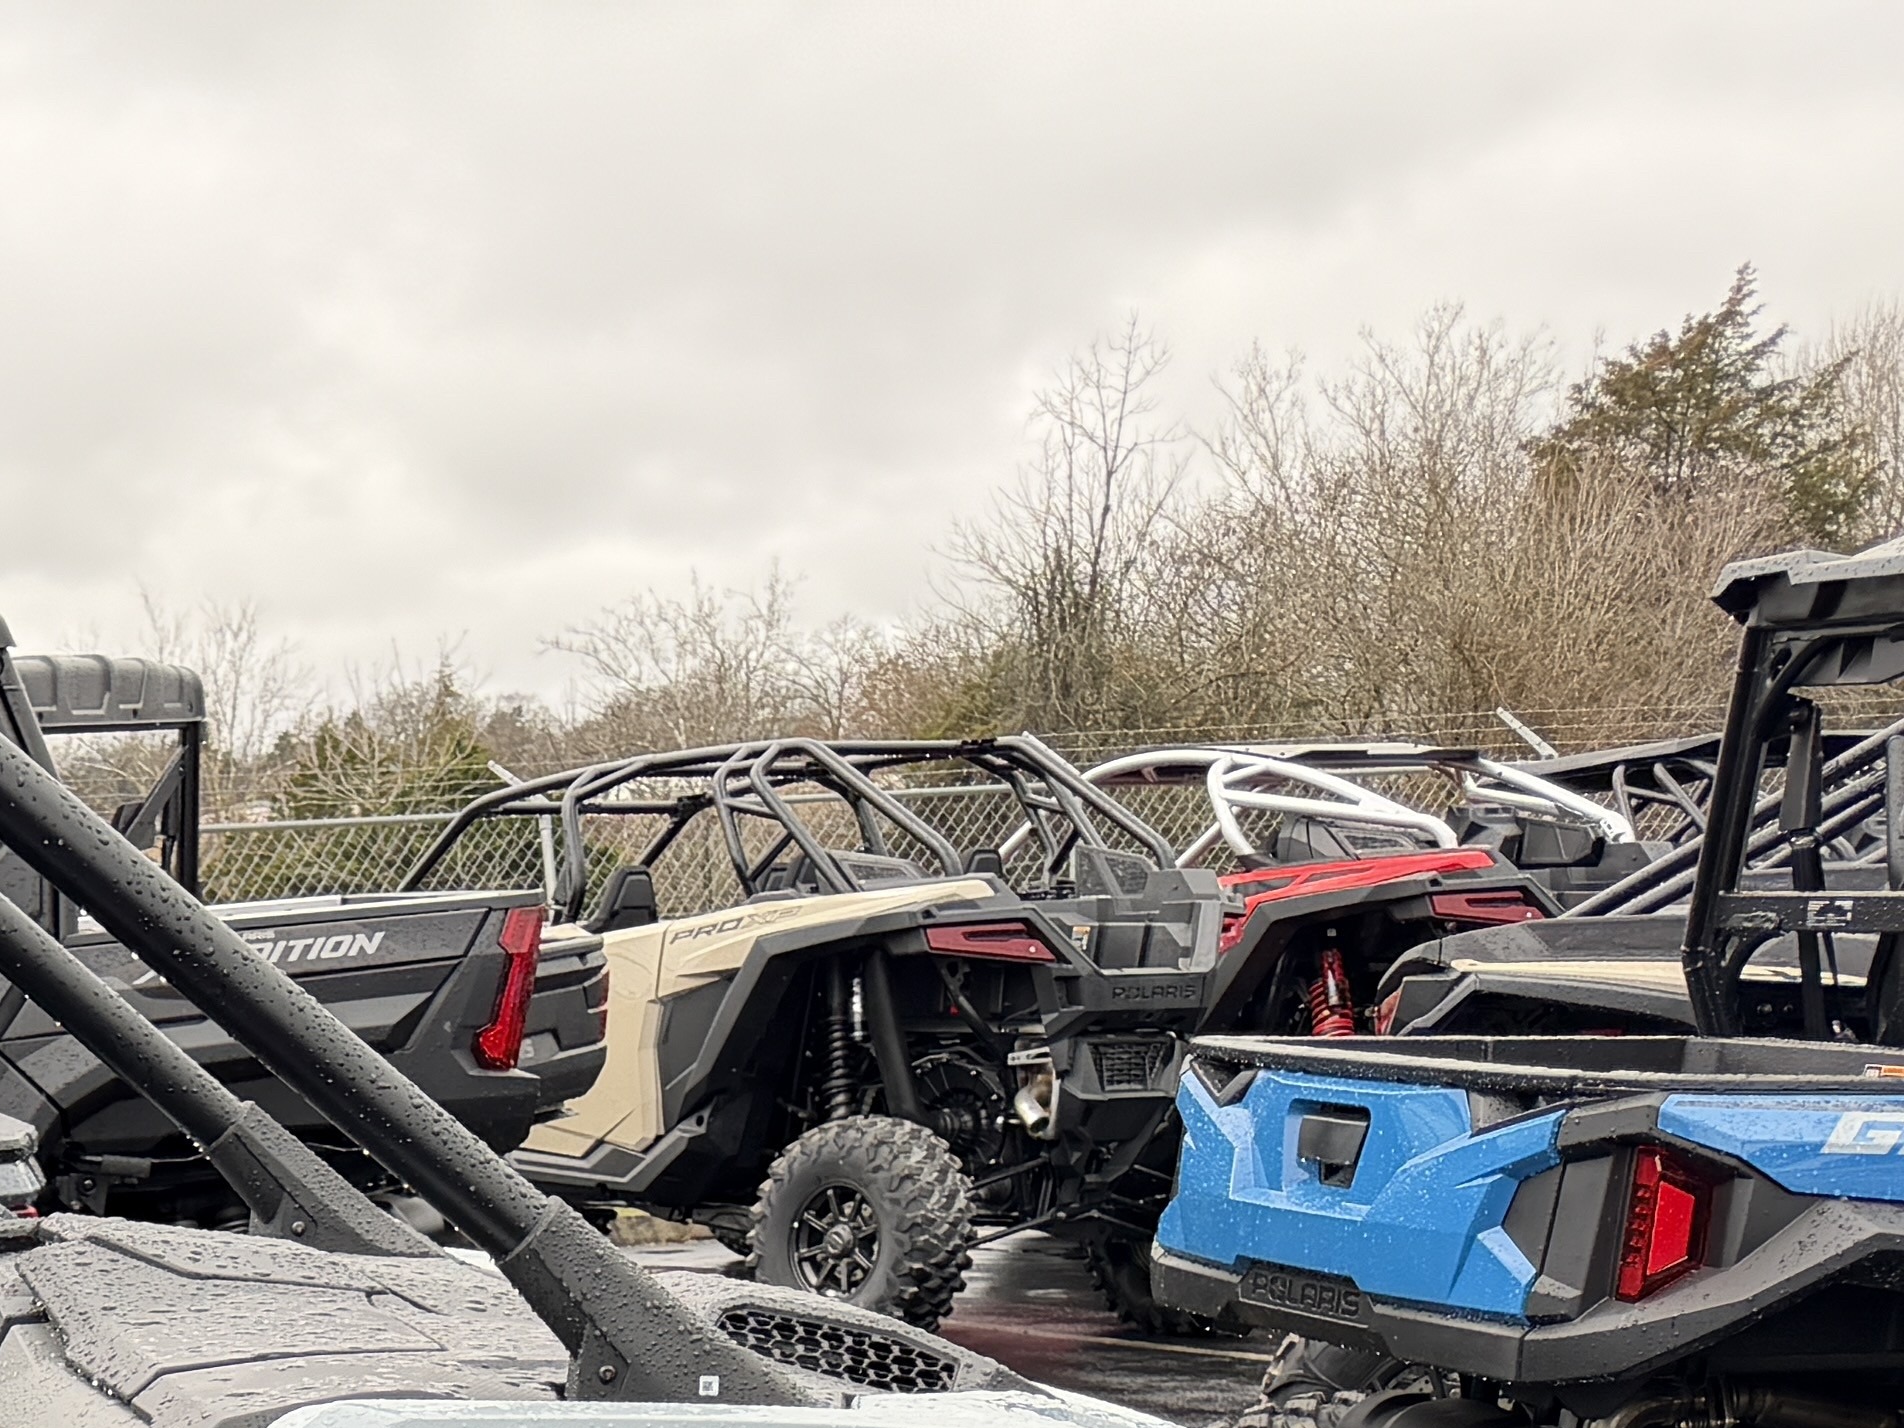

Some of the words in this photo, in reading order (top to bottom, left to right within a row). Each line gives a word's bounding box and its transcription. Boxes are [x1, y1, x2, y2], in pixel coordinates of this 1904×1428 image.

[669, 918, 744, 945] PRO
[247, 931, 386, 963] DITION
[1112, 984, 1196, 999] POLARIS
[1252, 1272, 1362, 1317] POLARIS
